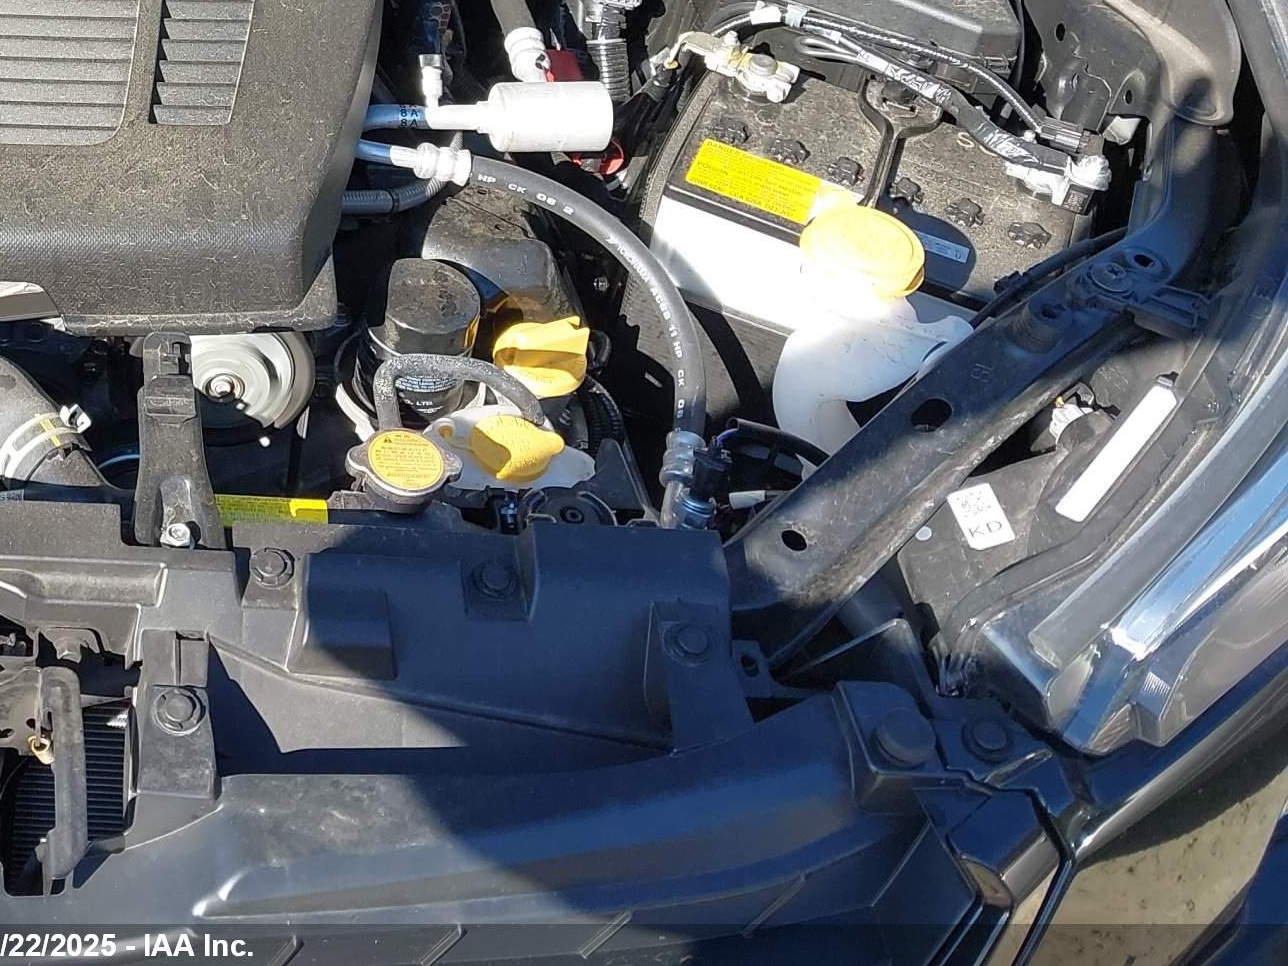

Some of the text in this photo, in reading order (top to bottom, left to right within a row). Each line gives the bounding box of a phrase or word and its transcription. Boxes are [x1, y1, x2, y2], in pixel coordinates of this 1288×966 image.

[477, 173, 497, 184] HP
[507, 183, 528, 194] CK
[968, 520, 1003, 538] KD
